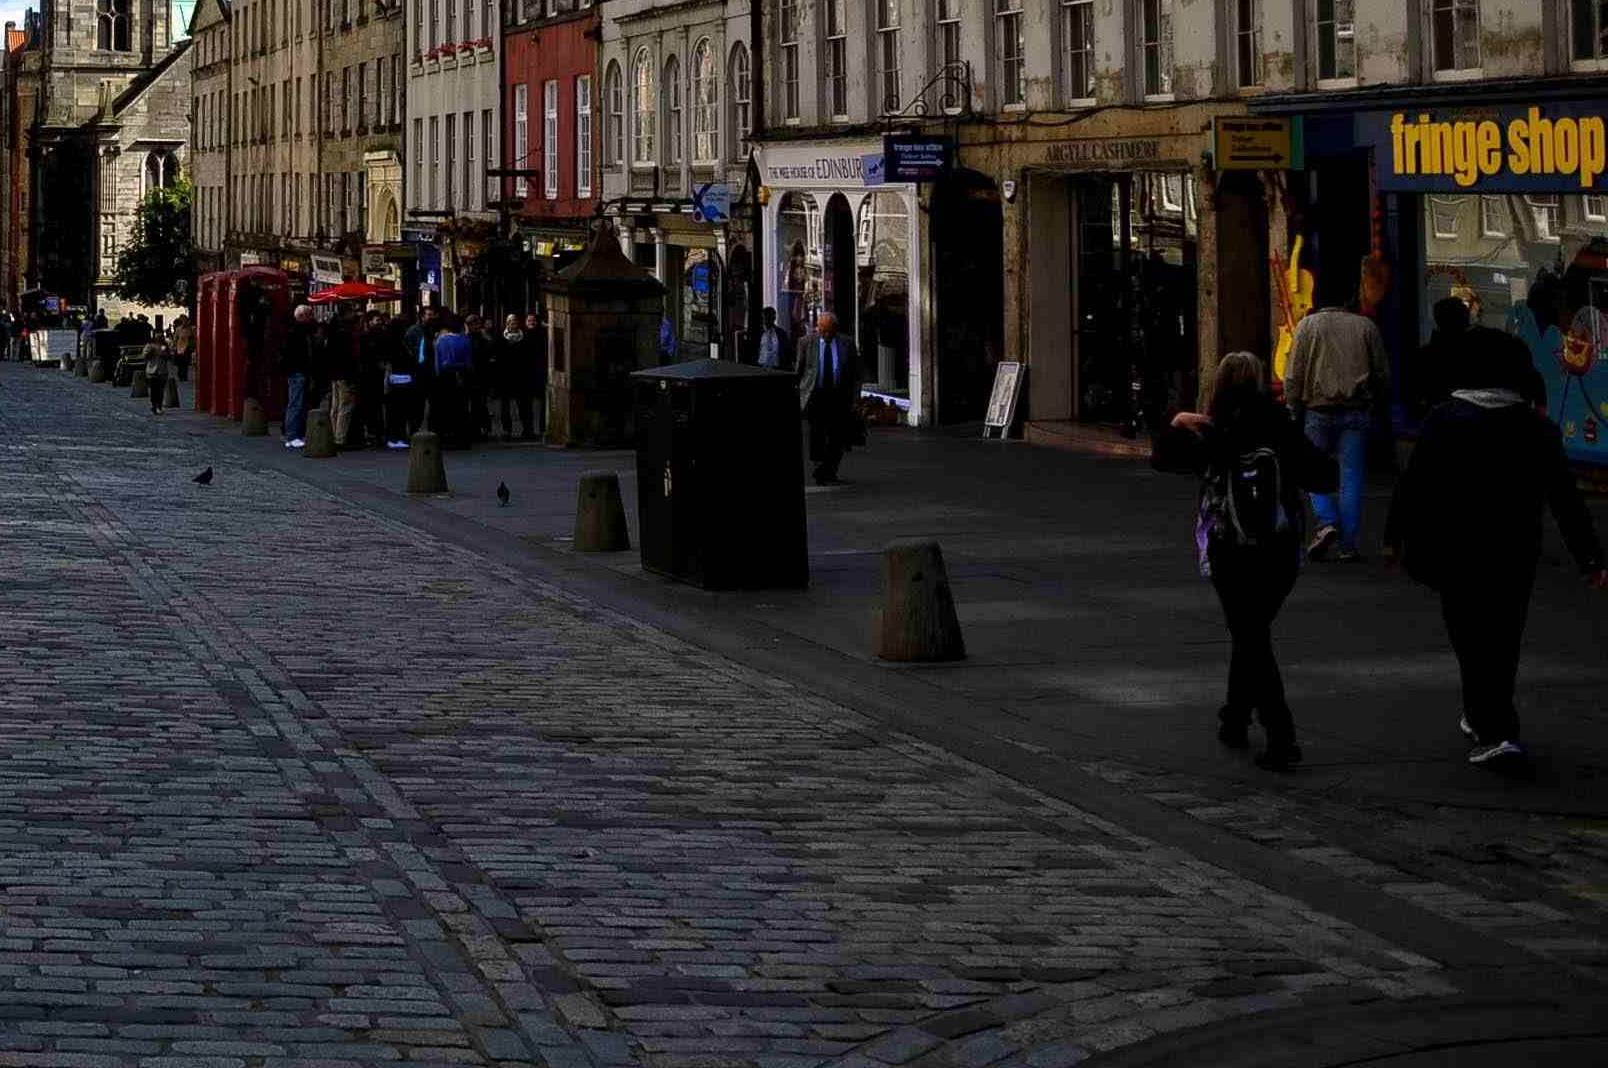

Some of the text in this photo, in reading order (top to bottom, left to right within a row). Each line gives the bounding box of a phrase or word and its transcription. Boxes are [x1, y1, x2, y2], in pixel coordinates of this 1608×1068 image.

[816, 157, 865, 179] EDINBUR
[1390, 106, 1606, 187] fringe shop
